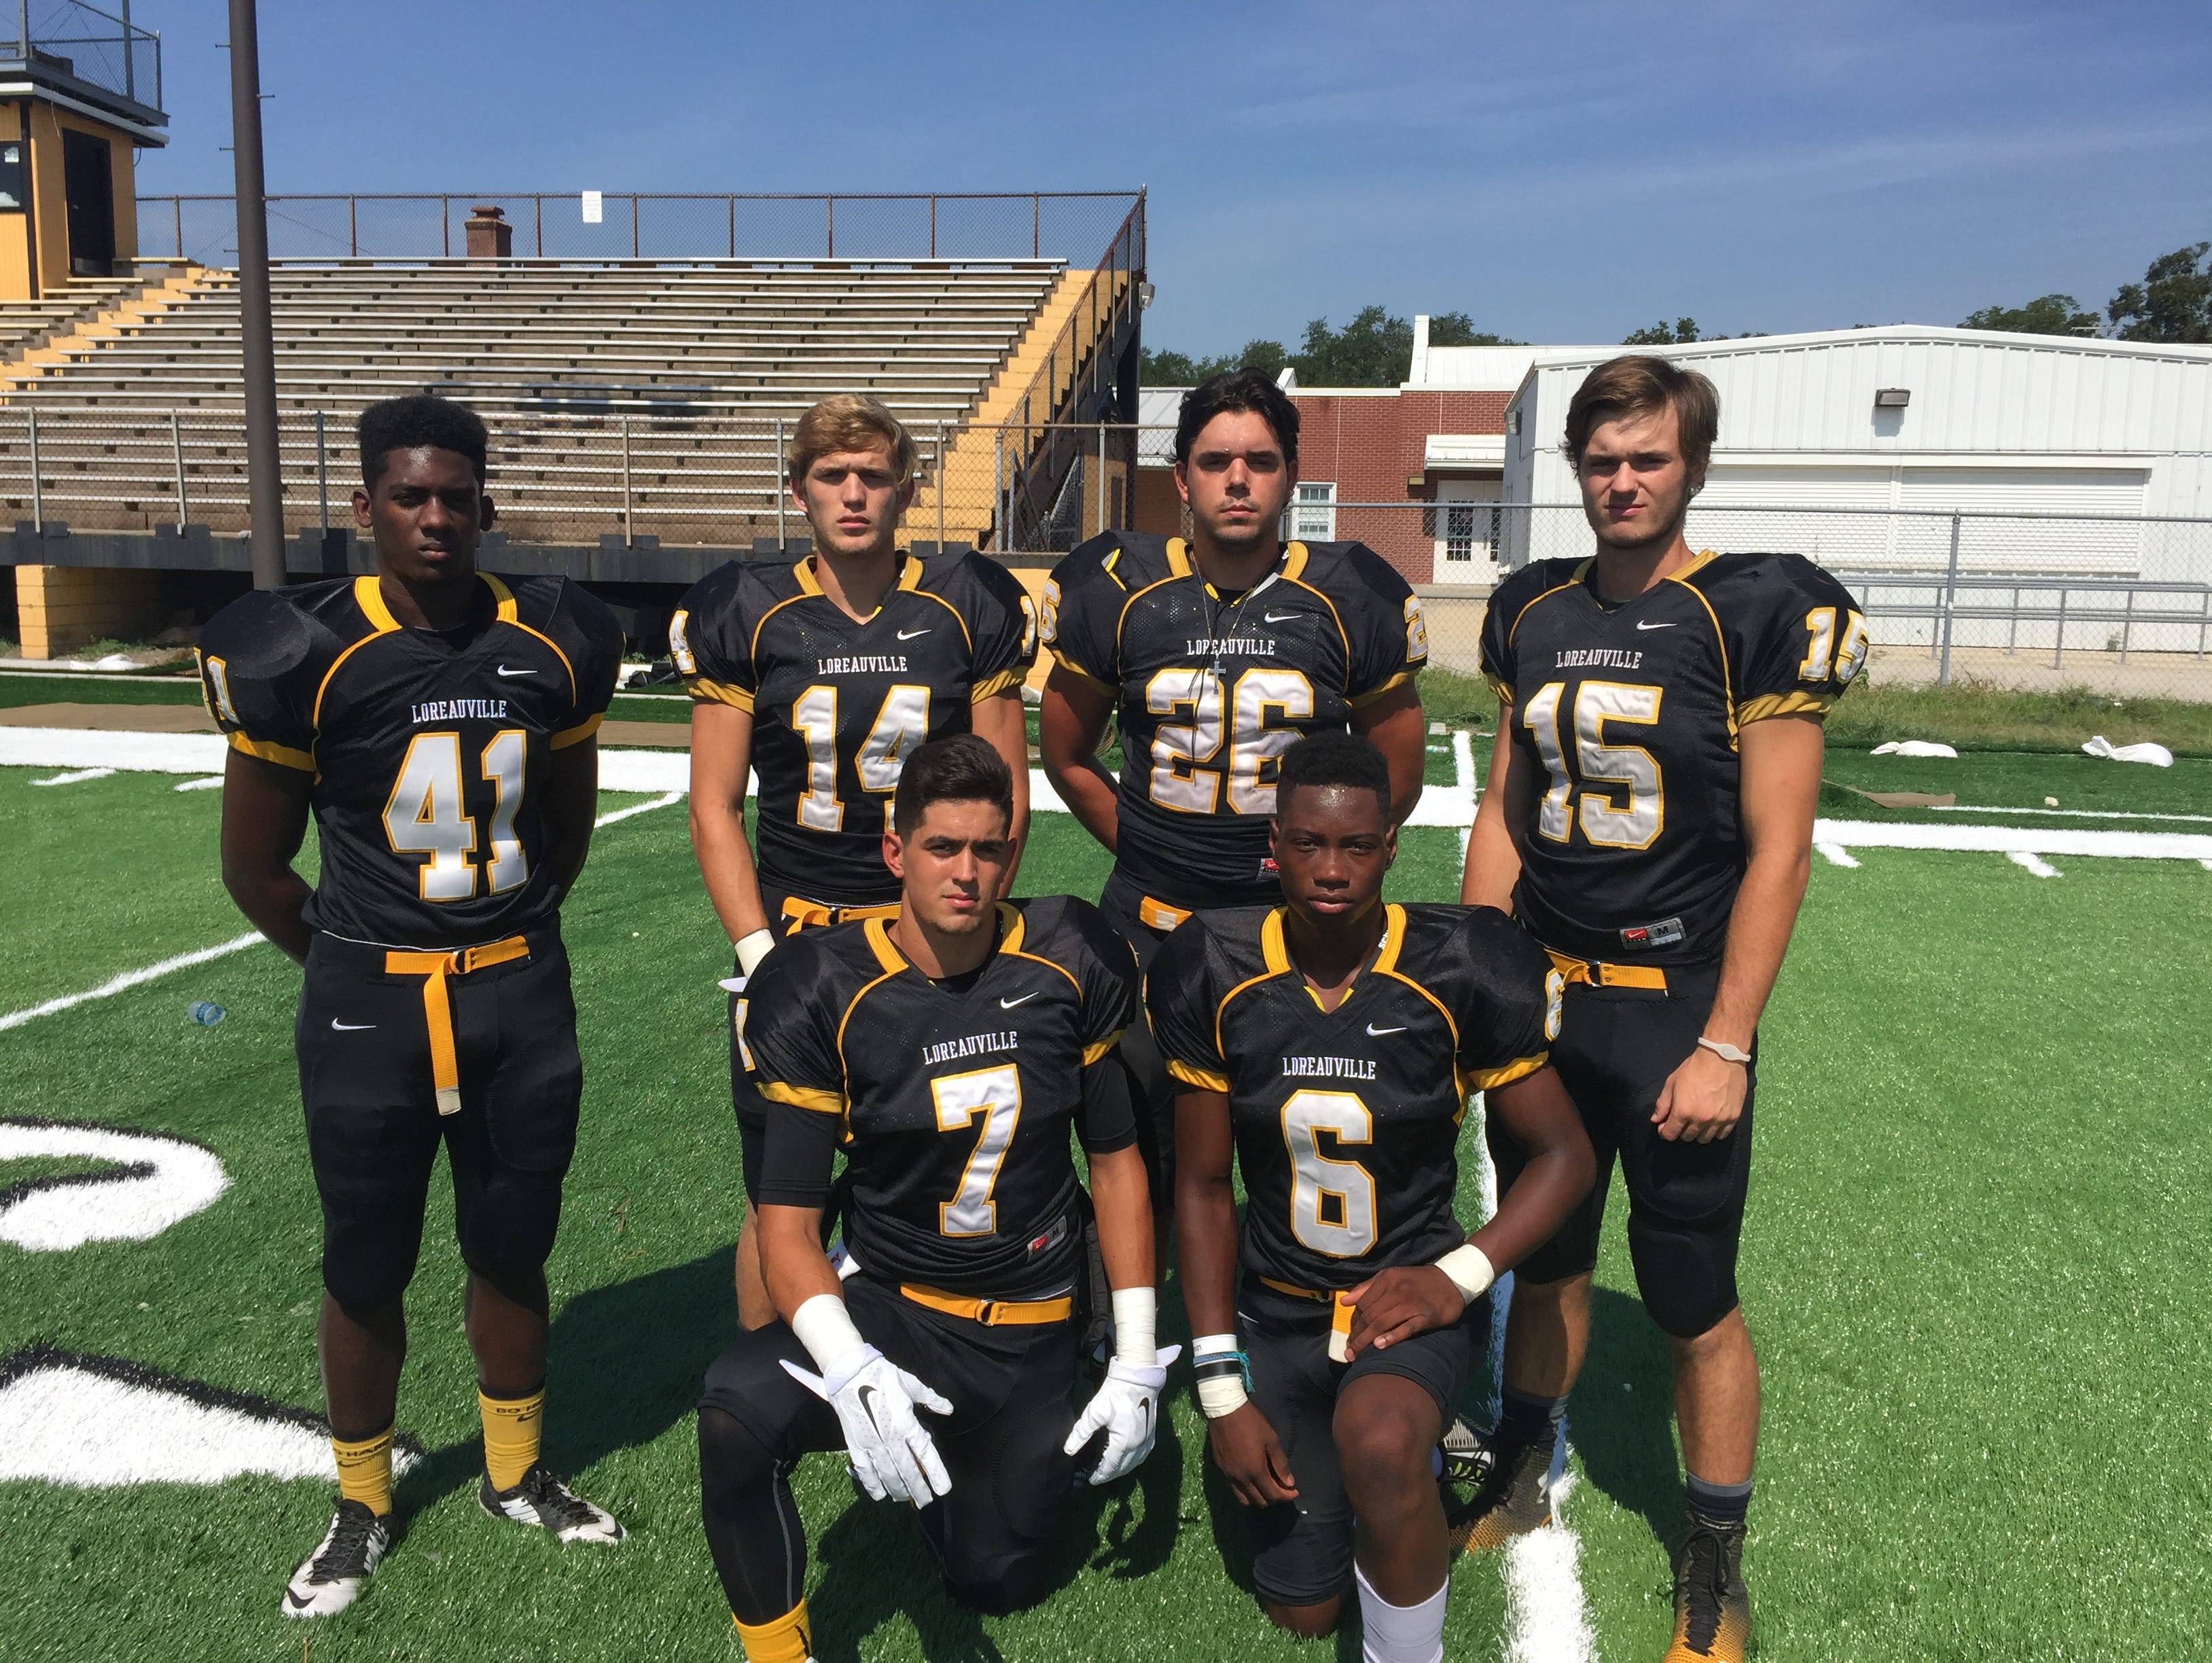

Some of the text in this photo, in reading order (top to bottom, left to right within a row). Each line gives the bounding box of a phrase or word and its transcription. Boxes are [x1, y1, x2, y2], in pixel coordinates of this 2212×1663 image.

[817, 656, 908, 675] LOREAUVILLE
[1186, 639, 1276, 656] LOREAUVILLE
[1556, 649, 1642, 669] LOREAUVILLE
[1798, 607, 1868, 685] 15
[193, 647, 240, 724] 1
[411, 699, 507, 723] LOREAUVILLE
[793, 685, 931, 833] 14
[1146, 668, 1314, 815] 26
[1524, 681, 1664, 850] 15
[382, 730, 529, 902] 41
[1657, 927, 1669, 935] M
[923, 1031, 1018, 1065] LOREAUVILLE
[1283, 1056, 1376, 1080] LOREAUVILLE
[931, 1063, 1022, 1238] 7
[1281, 1089, 1378, 1257] 6
